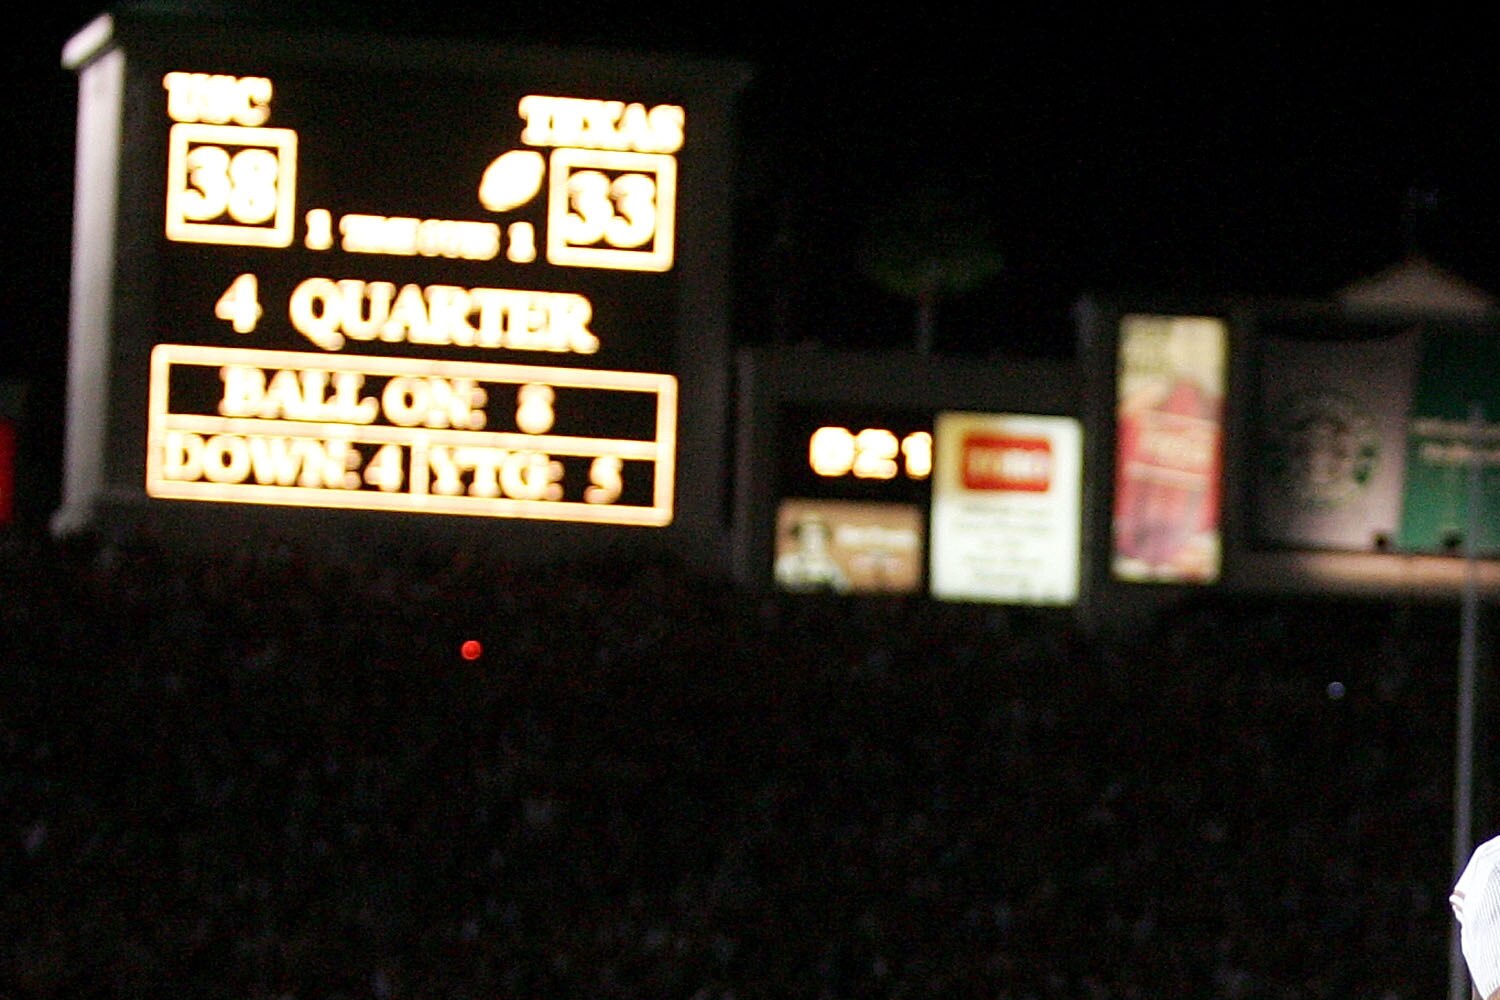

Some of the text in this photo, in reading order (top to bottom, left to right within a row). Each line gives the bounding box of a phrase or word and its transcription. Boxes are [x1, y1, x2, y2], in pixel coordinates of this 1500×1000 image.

[518, 95, 684, 153] TEXAS
[180, 145, 280, 225] 38
[563, 170, 657, 250] 33
[215, 273, 598, 354] 4 QUARTER
[219, 364, 379, 425] BALL
[364, 443, 404, 492] 4
